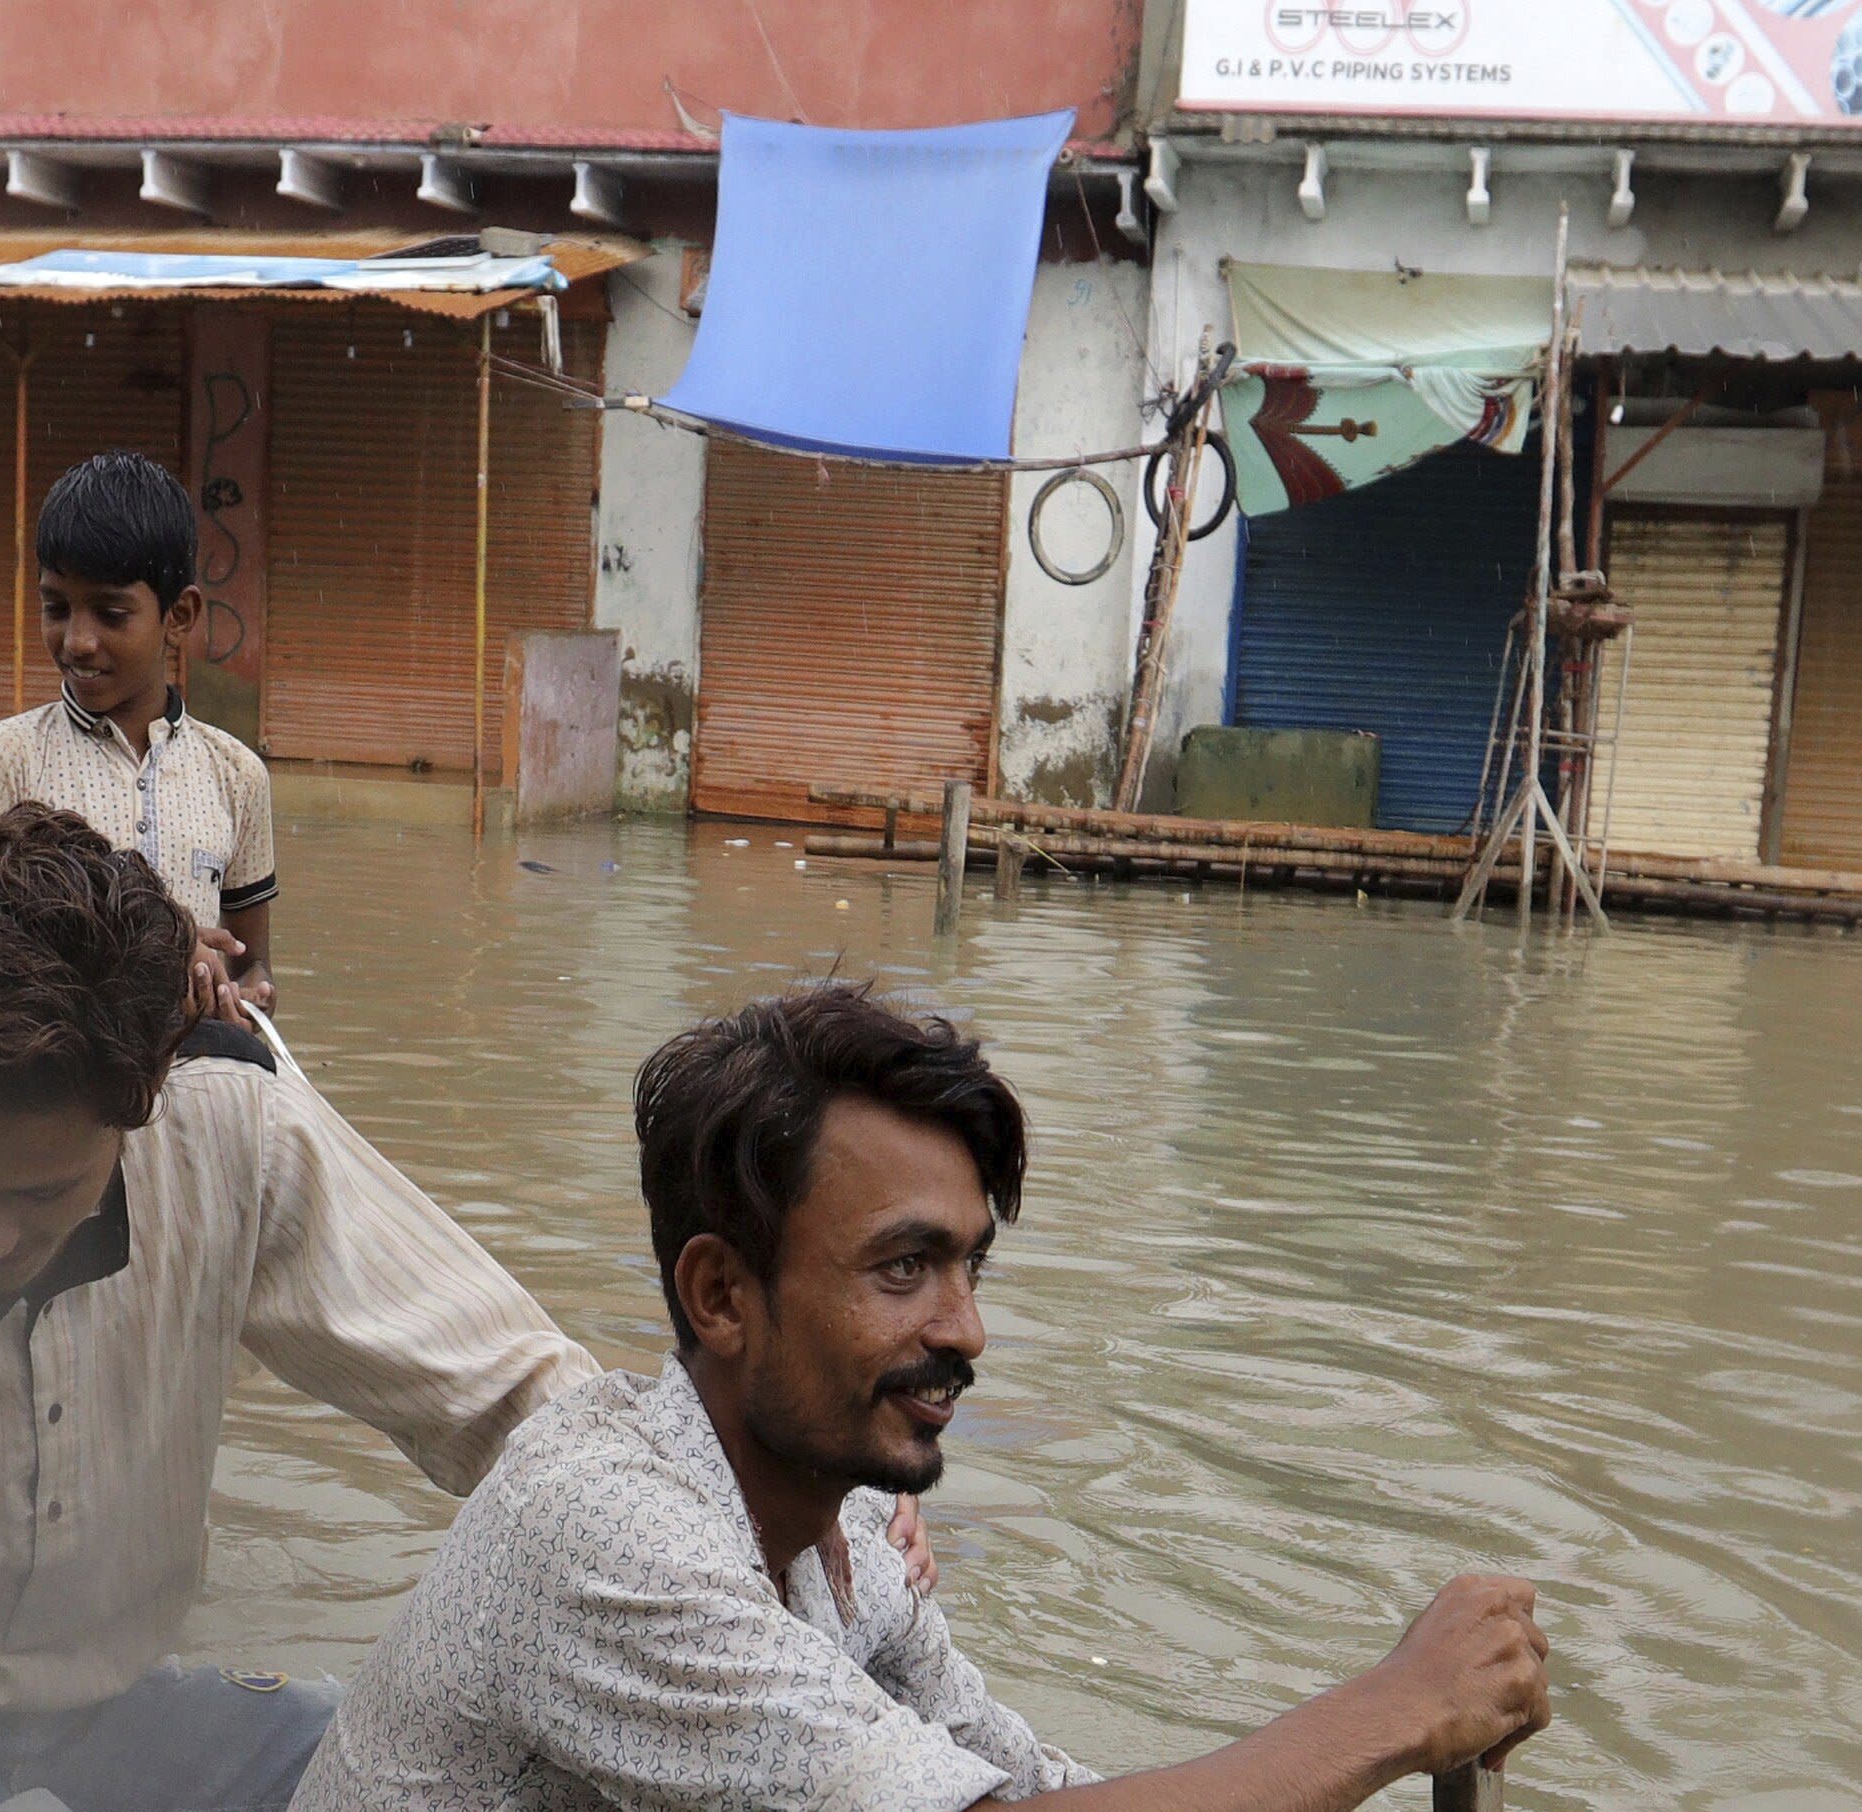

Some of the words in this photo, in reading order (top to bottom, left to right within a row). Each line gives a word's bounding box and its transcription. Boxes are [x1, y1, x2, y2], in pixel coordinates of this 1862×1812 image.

[1276, 8, 1457, 30] STEELEX
[1215, 58, 1243, 77] G.I
[1249, 59, 1262, 78] &
[1269, 60, 1326, 79] P.V.C
[1332, 61, 1404, 81] PIPING
[1410, 63, 1512, 83] SYSTEMS
